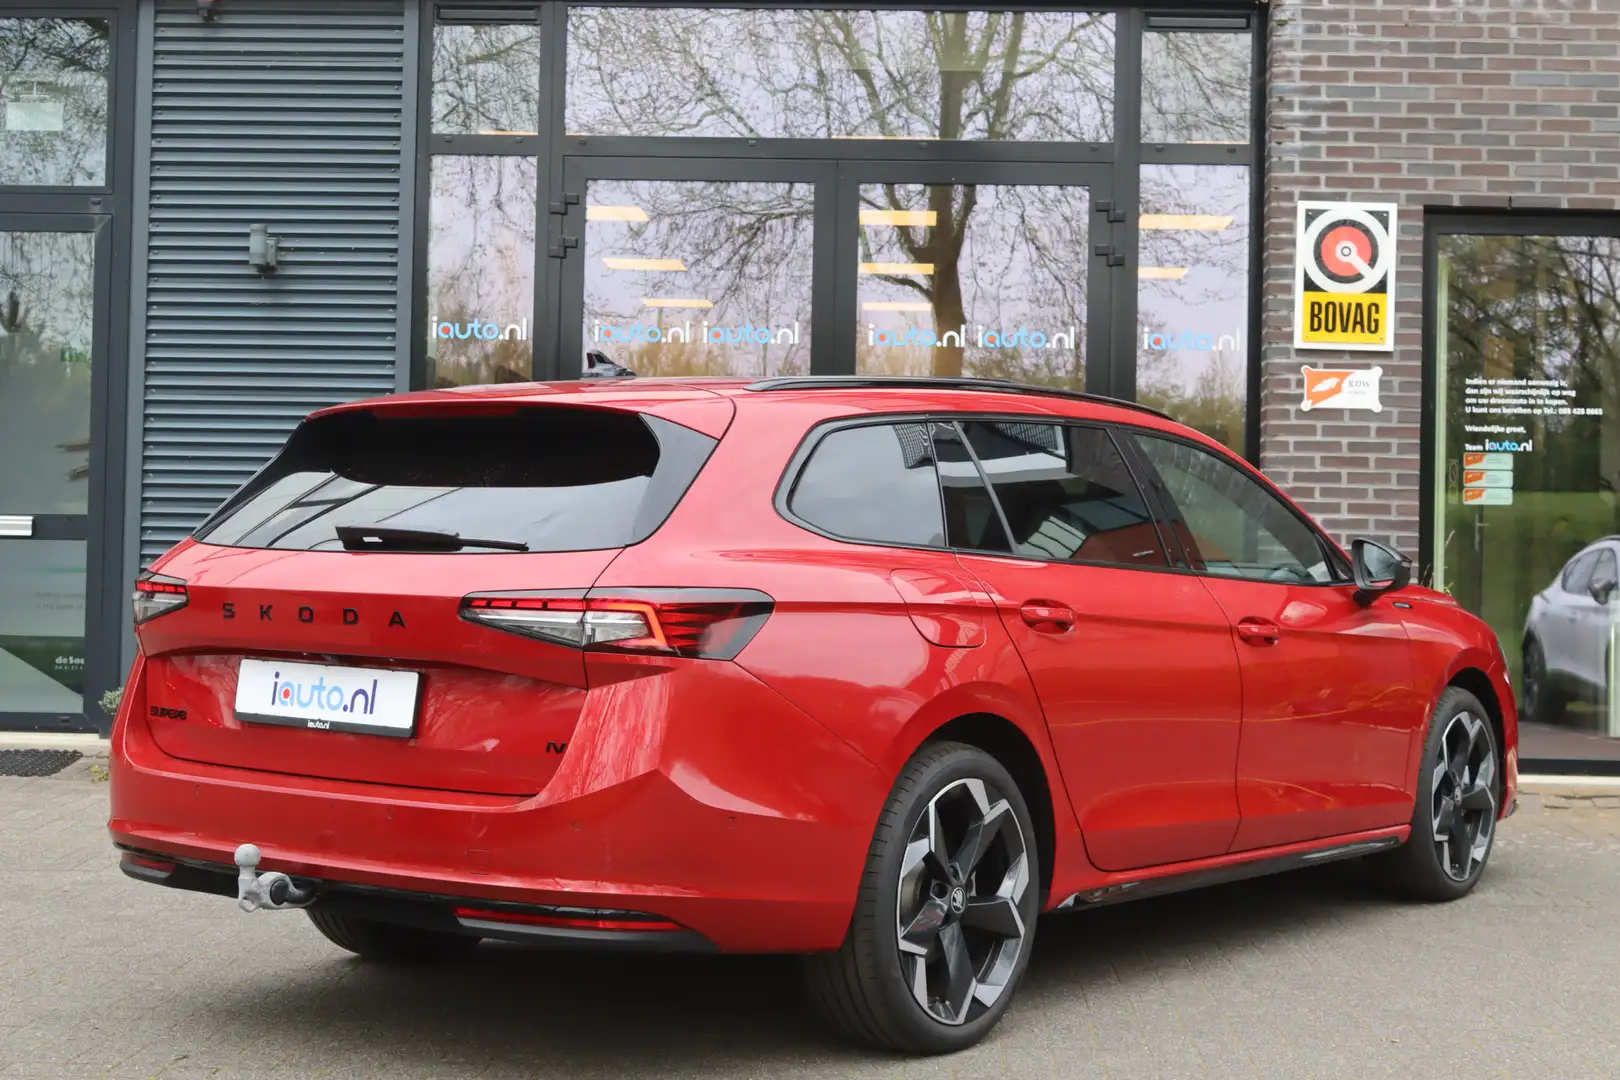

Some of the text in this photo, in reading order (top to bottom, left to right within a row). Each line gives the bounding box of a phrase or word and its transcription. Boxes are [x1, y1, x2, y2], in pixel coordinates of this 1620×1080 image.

[432, 316, 528, 340] iauto.nl
[1309, 301, 1380, 334] BOVAG
[594, 320, 799, 344] iauto.nl iauto.nl
[867, 323, 1075, 349] iauto.nl iauto.nl
[1143, 326, 1241, 351] iauto.nl
[1465, 425, 1505, 434] Vriendelijke
[1464, 439, 1533, 451] Team iauto.nl
[271, 671, 378, 715] iauto.nl
